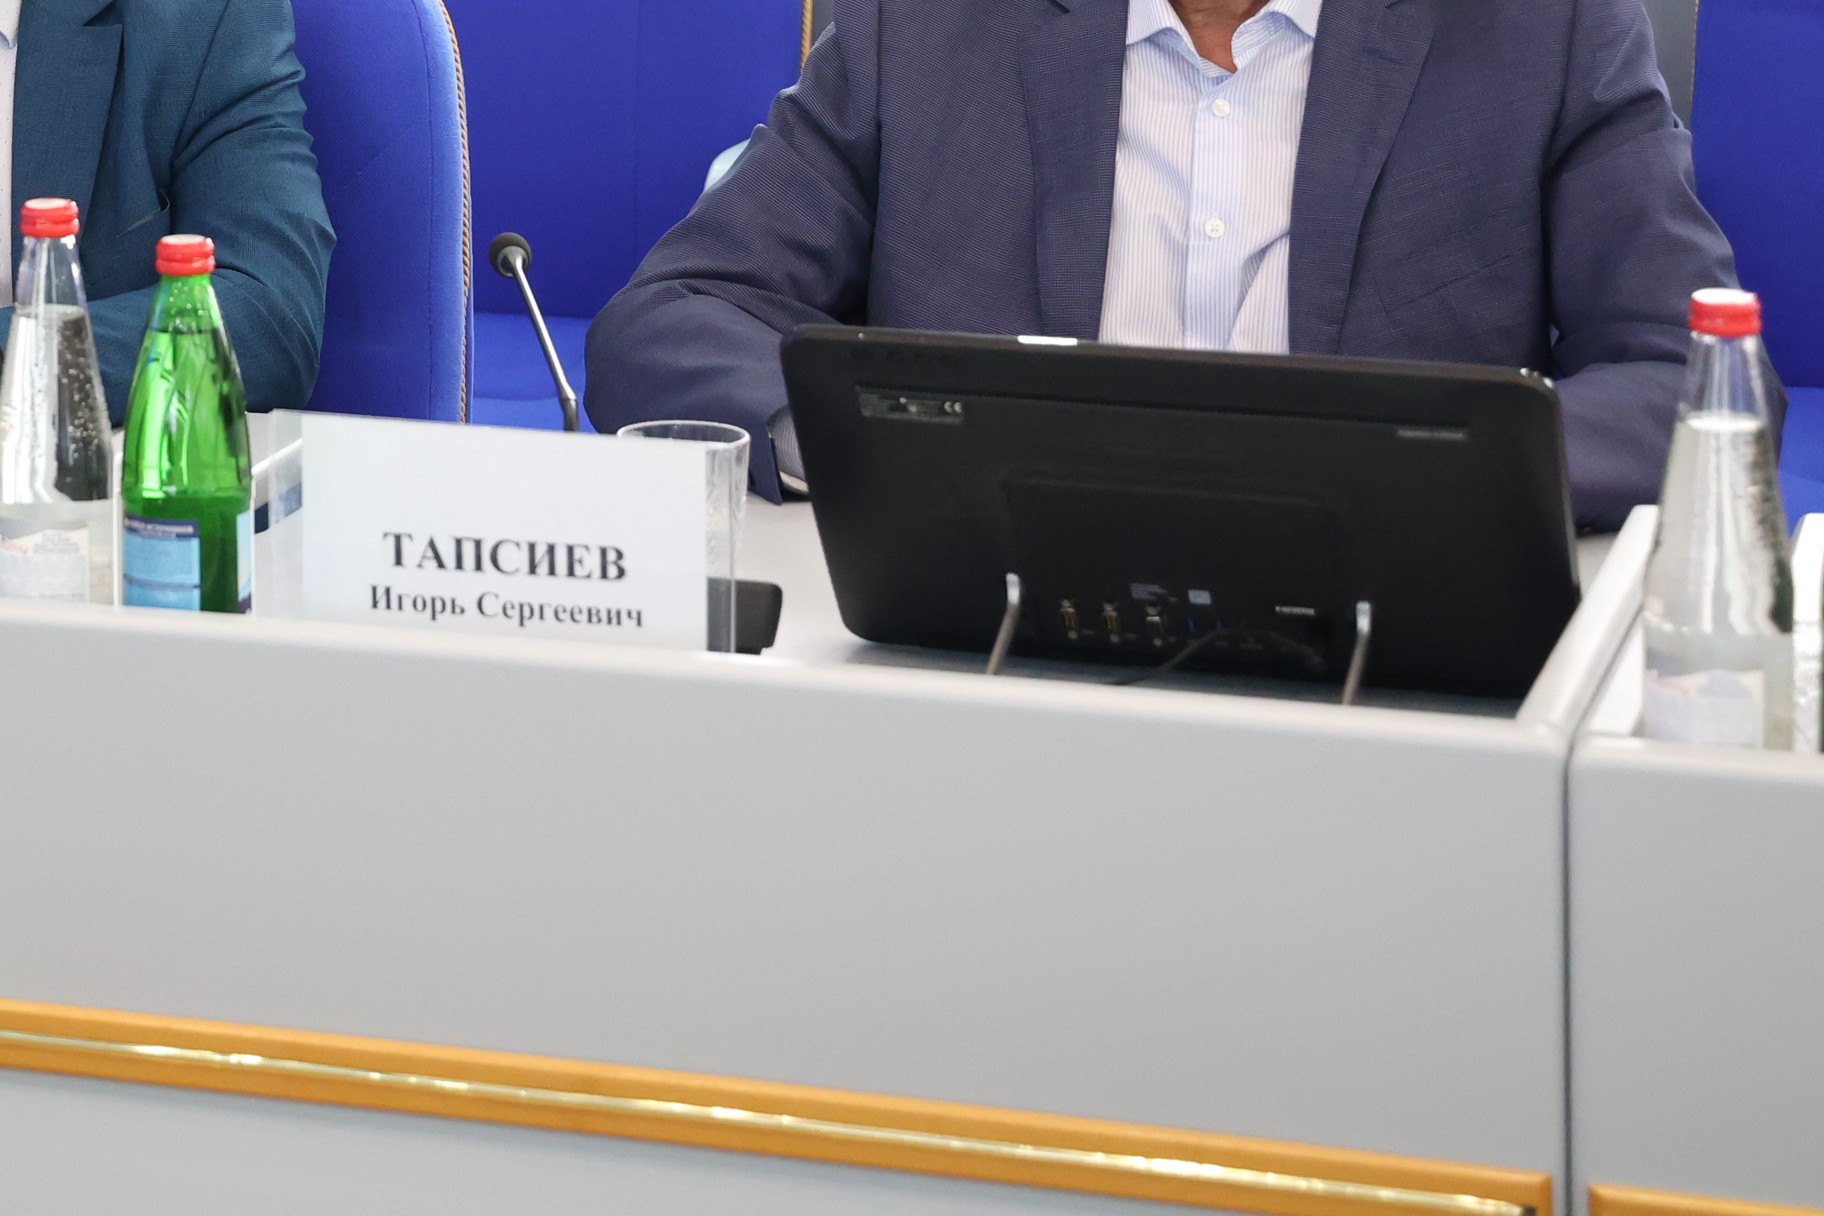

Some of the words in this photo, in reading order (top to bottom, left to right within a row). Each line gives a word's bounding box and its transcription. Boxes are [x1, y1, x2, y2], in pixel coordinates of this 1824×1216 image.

[382, 531, 627, 581] ТАПСИЕВ
[370, 585, 466, 622] Игорь
[476, 591, 644, 628] Сергеевич
